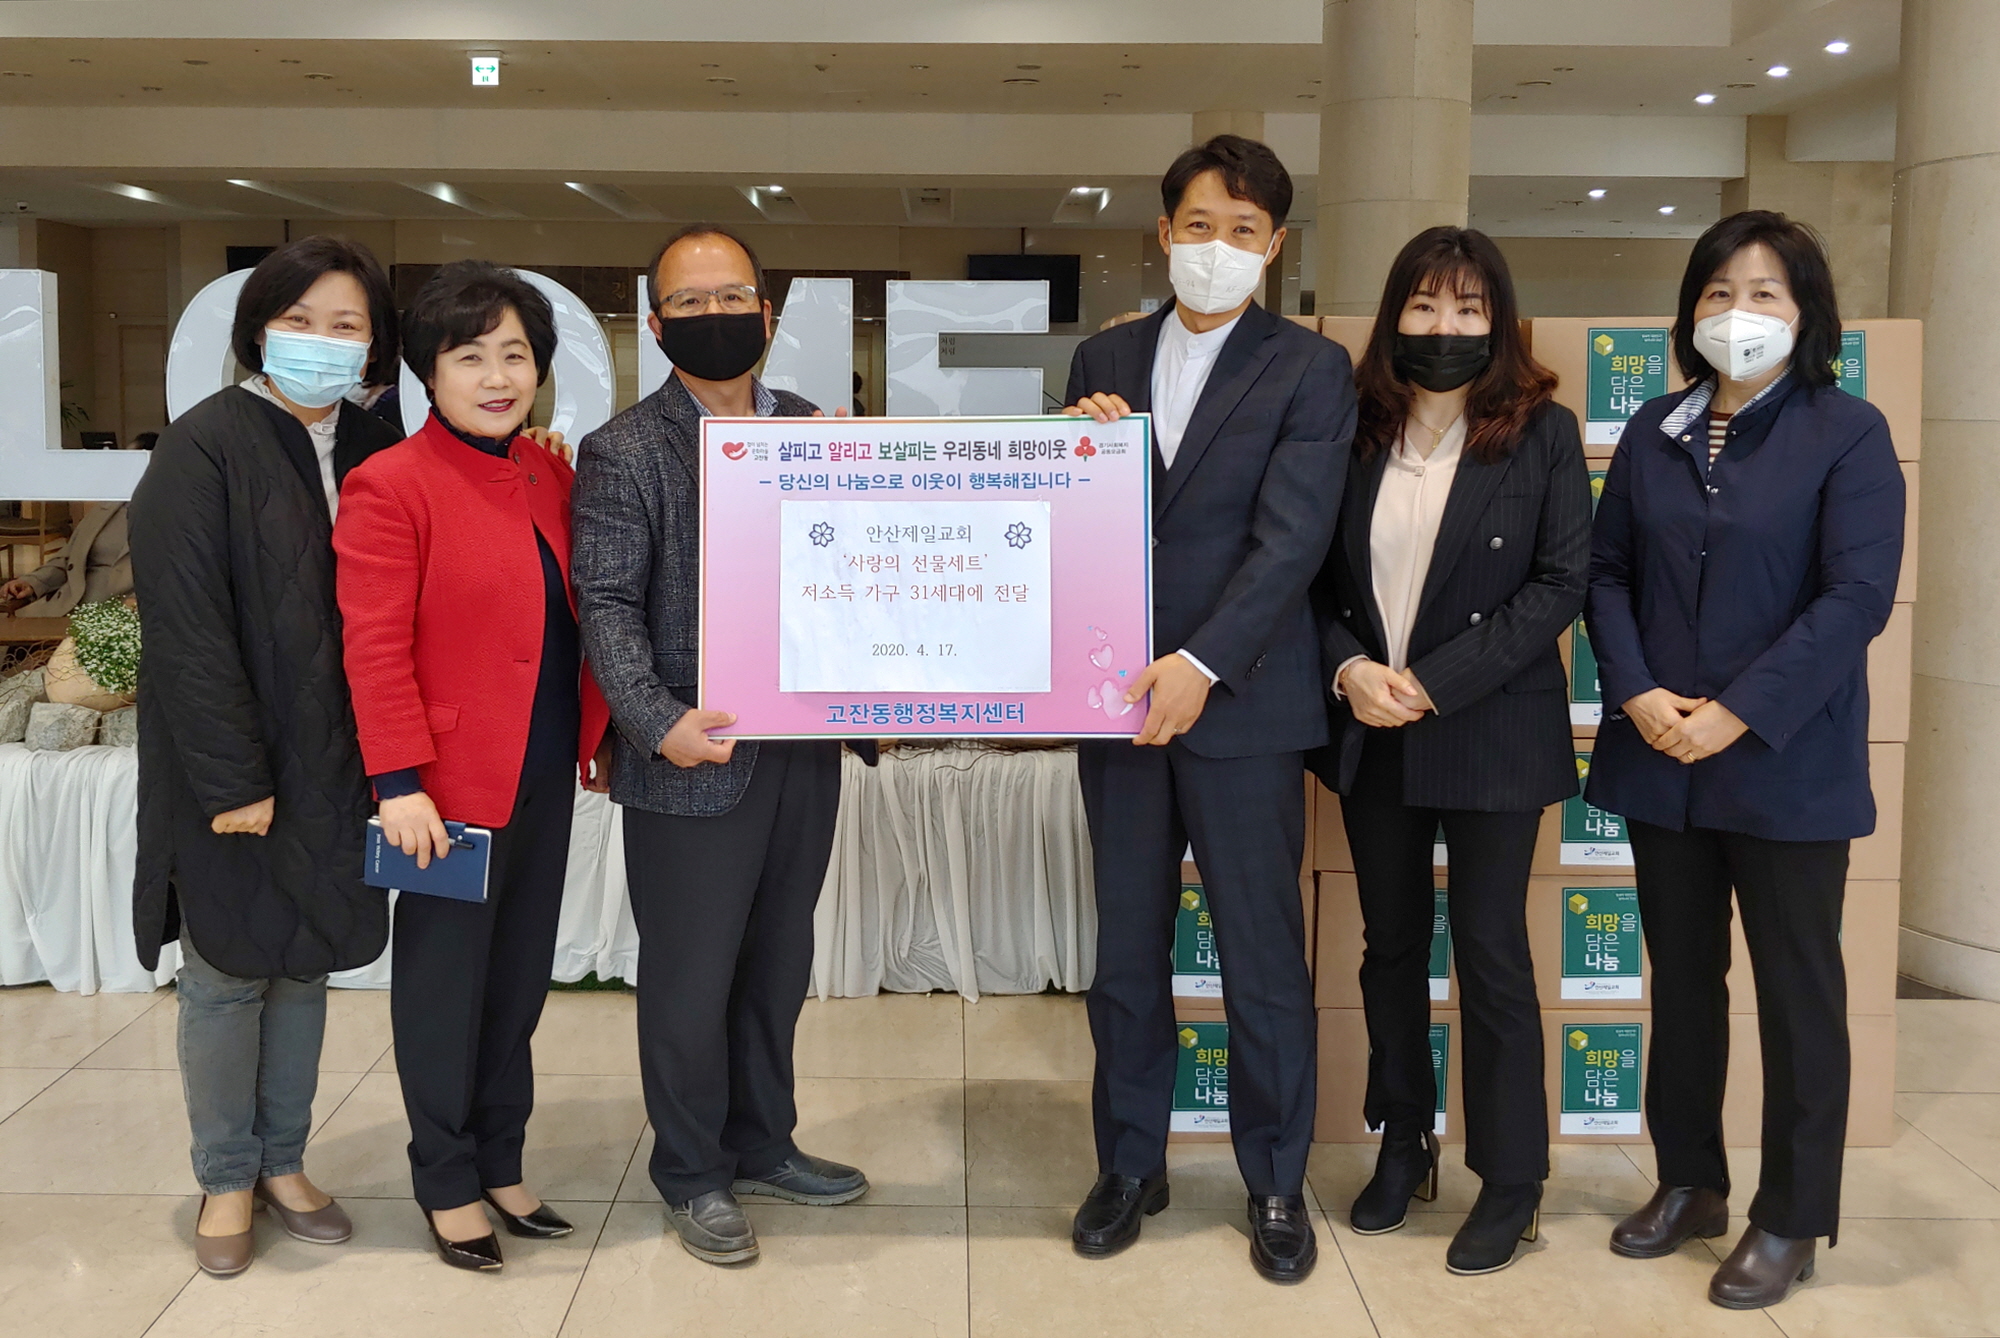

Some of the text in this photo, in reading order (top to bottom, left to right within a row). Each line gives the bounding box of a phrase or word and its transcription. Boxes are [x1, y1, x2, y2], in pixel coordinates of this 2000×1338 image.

[1611, 354, 1664, 375] 희망을
[1611, 375, 1646, 395] 담은
[1610, 396, 1644, 416] 나눔
[778, 439, 1067, 462] 살피고 알리고 보살피는 우리동네 희망이웃
[779, 473, 829, 491] 당신의
[837, 473, 905, 490] 나눔으로
[912, 472, 961, 490] 이웃이
[969, 471, 1071, 490] 행복해집니다
[866, 524, 973, 544] 안산제일교회
[801, 583, 1030, 603] 저소득 가구 31세대에 전달
[872, 643, 957, 657] 2020. 4. 17.
[825, 702, 1025, 725] 고잔동행정복지센터
[1585, 818, 1621, 837] 나눔
[1585, 912, 1638, 932] 희망을
[1585, 933, 1620, 952] 담은
[1585, 952, 1620, 971] 나눔
[1195, 1047, 1229, 1067] 희망
[1585, 1049, 1637, 1068] 희망을
[1195, 1067, 1228, 1086] 담은
[1585, 1069, 1620, 1088] 담은
[1195, 1086, 1229, 1106] 나눔
[1584, 1088, 1620, 1107] 나눔
